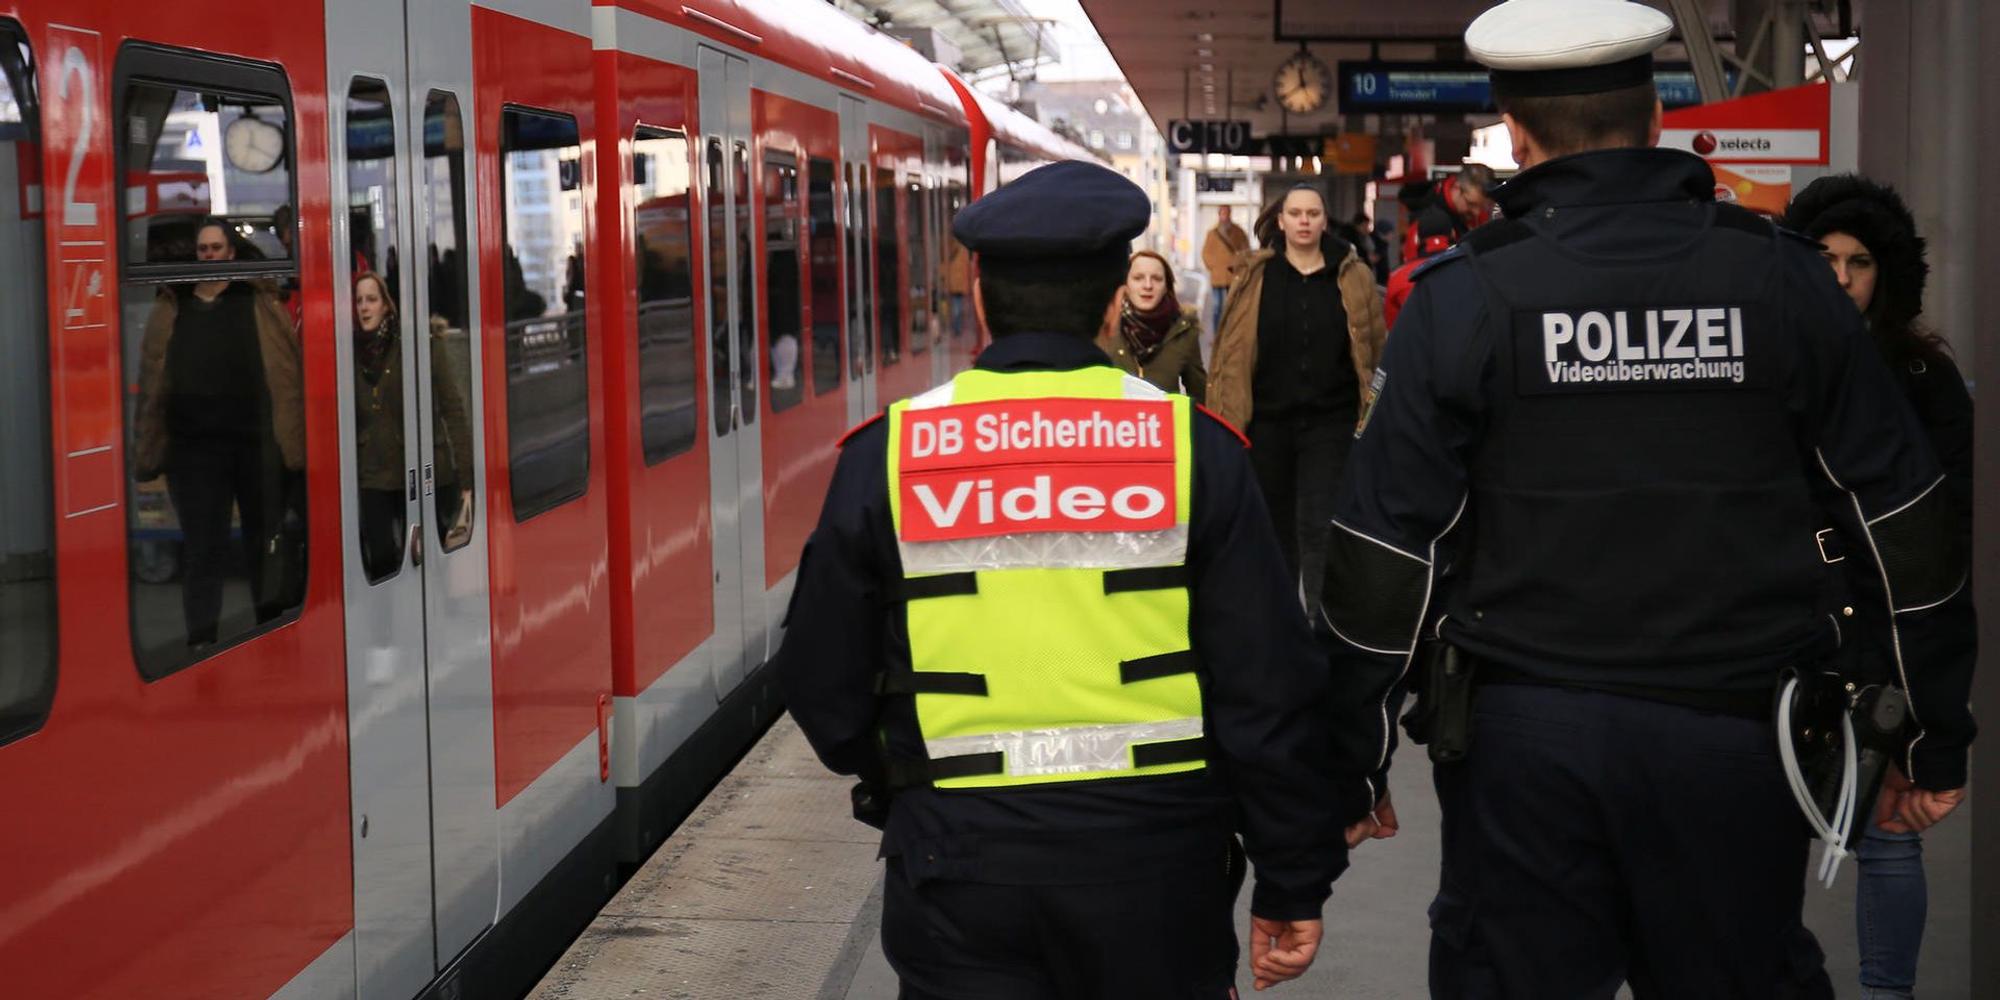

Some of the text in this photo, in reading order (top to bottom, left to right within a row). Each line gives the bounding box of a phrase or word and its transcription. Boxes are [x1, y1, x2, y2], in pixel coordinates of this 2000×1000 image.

[1353, 73, 1376, 95] 10
[60, 47, 97, 226] 2
[1171, 122, 1193, 150] C
[1211, 122, 1243, 150] 10
[1720, 137, 1771, 151] selecta
[1542, 307, 1744, 361] POLIZEI
[1547, 358, 1744, 383] Videoüberwachung
[911, 411, 1161, 458] DB Sicherheit
[912, 476, 1165, 528] Video
